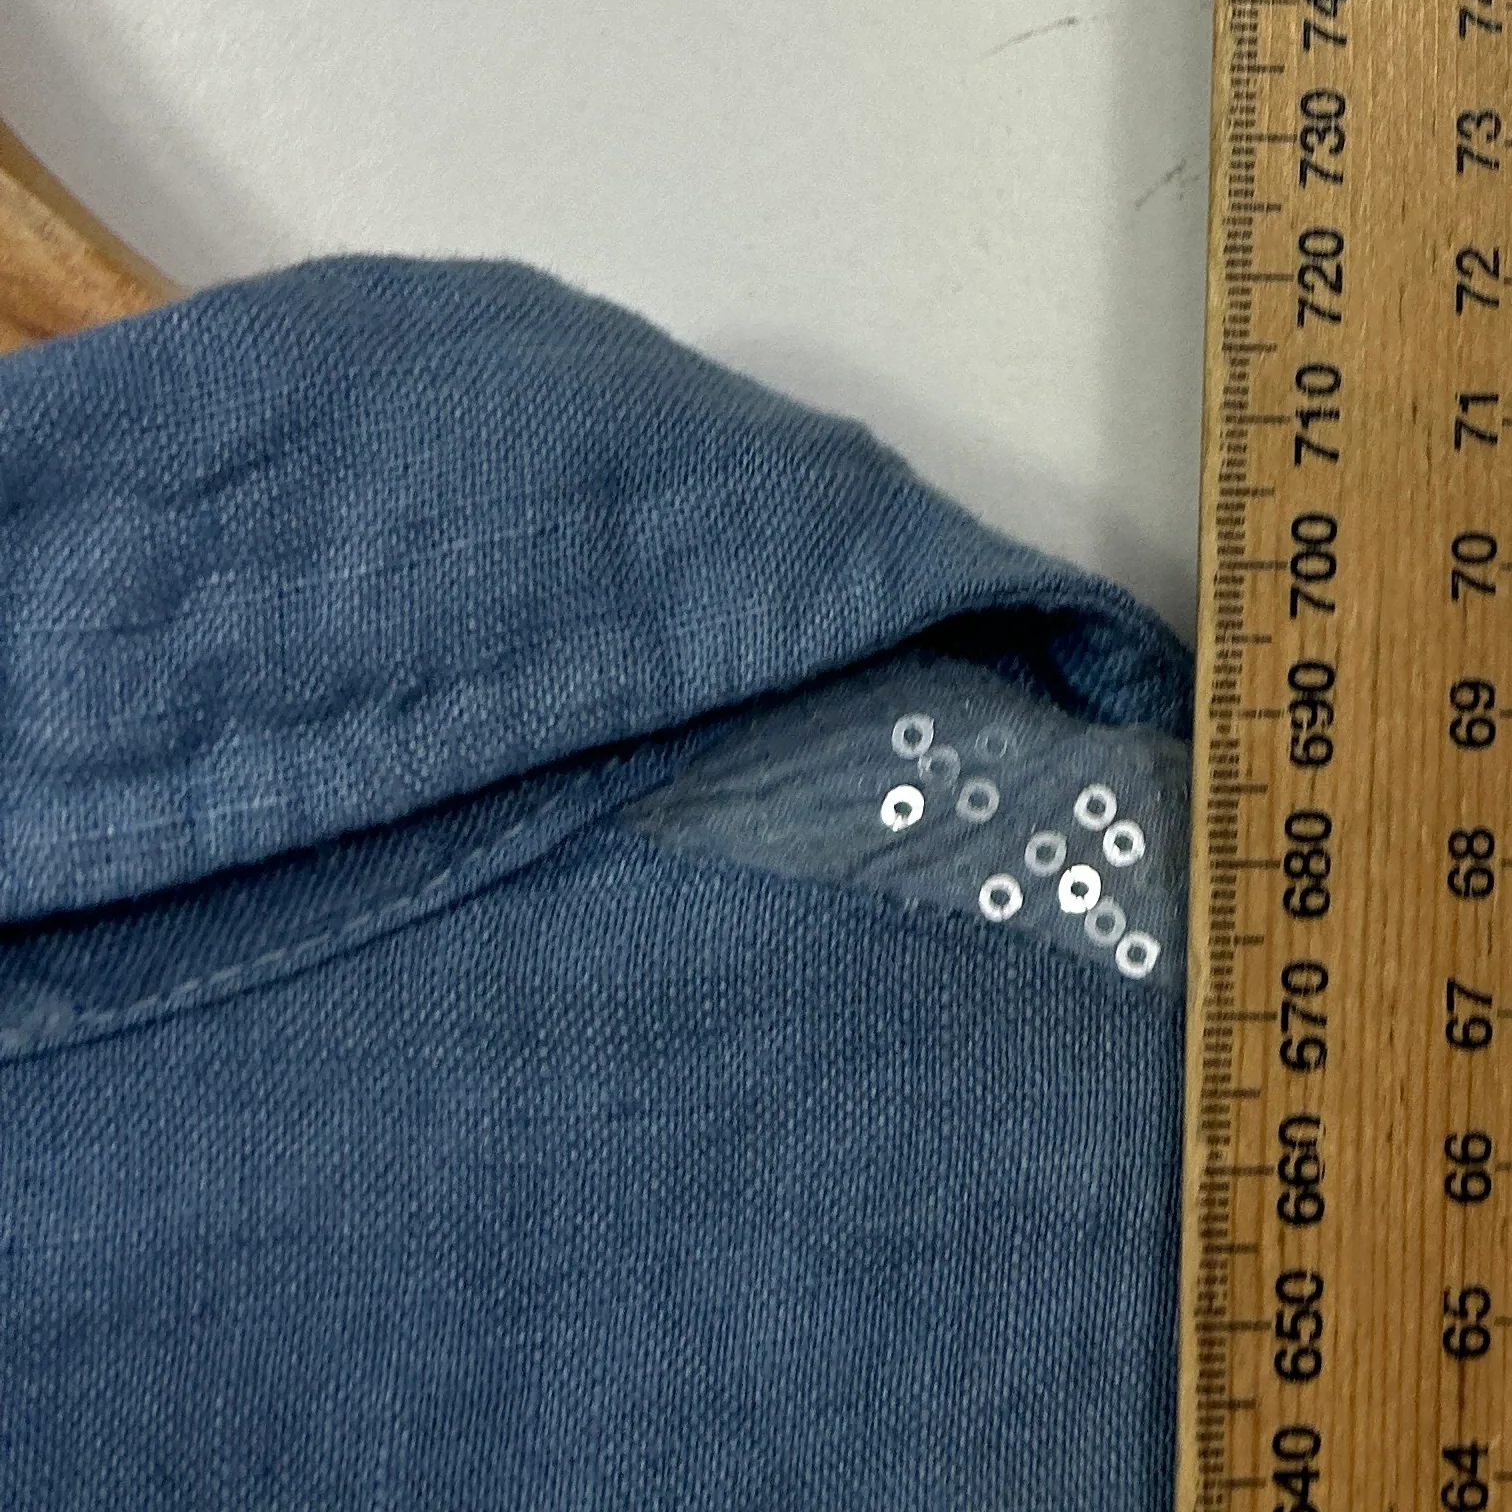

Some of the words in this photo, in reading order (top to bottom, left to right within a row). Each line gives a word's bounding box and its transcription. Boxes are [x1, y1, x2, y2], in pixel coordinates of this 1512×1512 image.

[1299, 90, 1345, 188] 730
[1457, 110, 1501, 174] 73
[1298, 228, 1344, 327] 720
[1456, 248, 1499, 316] 72
[1294, 365, 1341, 467] 710
[1455, 392, 1498, 451] 71
[1290, 512, 1337, 619] 700
[1452, 531, 1497, 602] 70
[1288, 661, 1336, 769] 690
[1449, 678, 1496, 750] 69
[1283, 810, 1332, 921] 680
[1447, 827, 1495, 902] 68
[1280, 961, 1328, 1074] 670
[1446, 977, 1493, 1054] 67
[1276, 1113, 1326, 1228] 660
[1444, 1130, 1492, 1205] 66
[1274, 1270, 1324, 1383] 650
[1442, 1285, 1491, 1361] 65
[1441, 1440, 1489, 1512] 64
